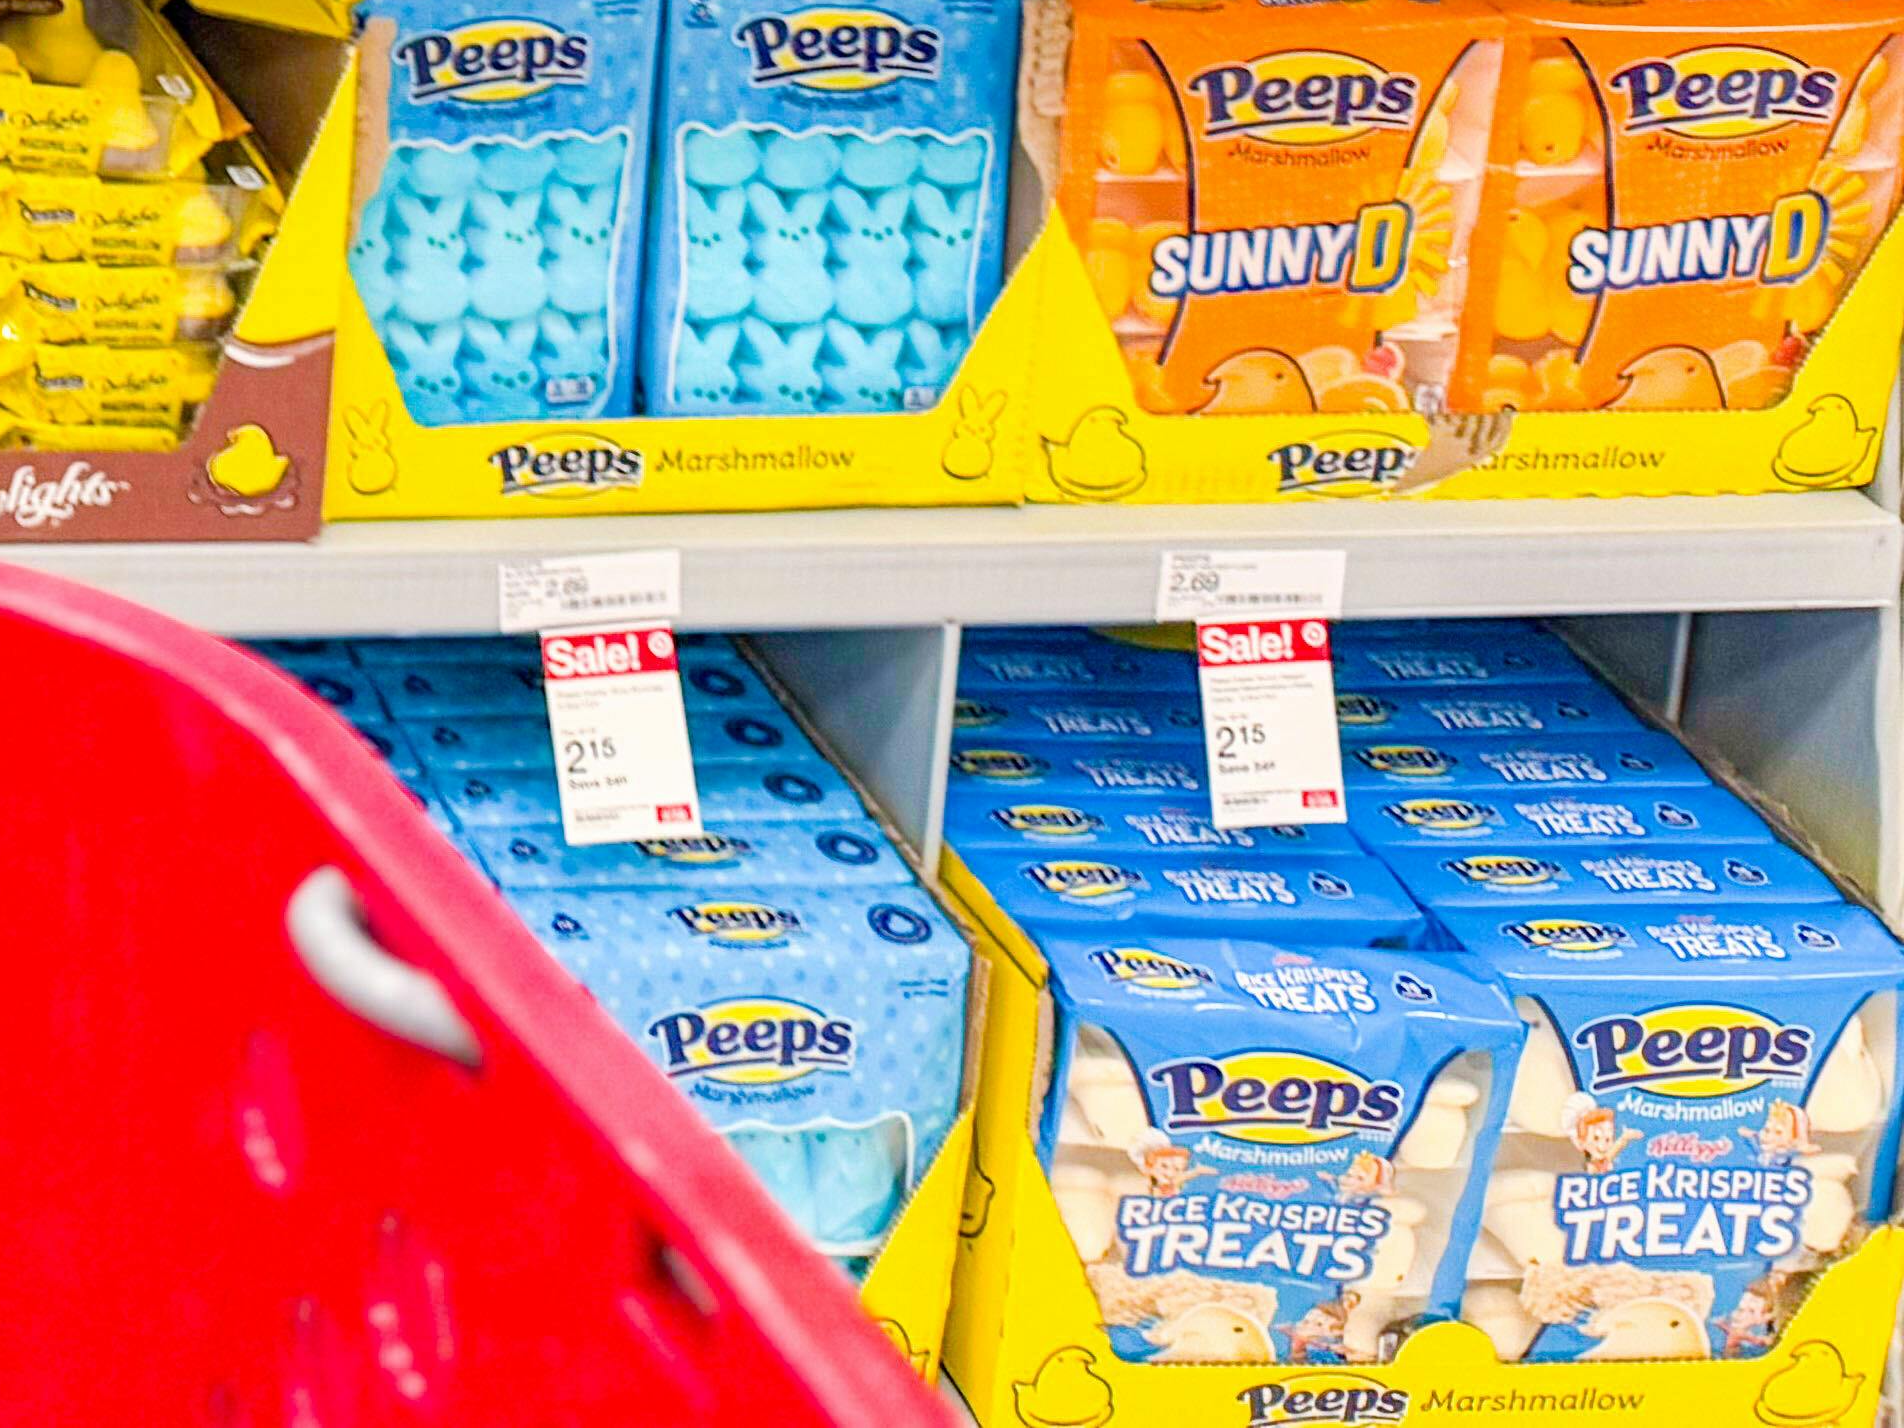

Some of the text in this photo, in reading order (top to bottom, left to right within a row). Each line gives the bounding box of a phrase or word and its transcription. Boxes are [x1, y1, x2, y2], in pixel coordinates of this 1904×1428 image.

[394, 29, 589, 91] Peeps
[736, 18, 940, 82] Peeps
[1190, 63, 1416, 130] Peeps
[1609, 58, 1838, 128] Peeps
[1226, 139, 1372, 169] Marshmallow
[1647, 134, 1790, 165] Marshmallow
[489, 439, 856, 492] Peeps Marshmallow
[1269, 440, 1666, 490] Peep arshmallow
[545, 633, 642, 677] Sale!
[1201, 623, 1296, 664] Sale!
[1492, 761, 1608, 784] TREATS
[1529, 813, 1647, 837] TREATS
[1021, 862, 1144, 889] Peeps
[1180, 881, 1296, 904] TREATS
[1592, 866, 1718, 893] TREATS
[669, 904, 800, 940] Peeps
[1502, 919, 1629, 948] Peeps
[1088, 946, 1214, 987] Peeps
[1661, 937, 1787, 961] TREATS
[1276, 967, 1369, 988] KRISPIES
[1252, 985, 1377, 1013] TREATS
[649, 1014, 853, 1070] Peeps
[1576, 1018, 1809, 1086] Peeps
[1151, 1064, 1401, 1134] Peeps
[1616, 1096, 1765, 1123] Marshmallow
[1195, 1137, 1350, 1166] Marshmallow
[1557, 1164, 1810, 1208] RICE KRISPIES
[1121, 1195, 1390, 1235] RICE KRISPIES
[1564, 1204, 1796, 1258] TREATS
[1125, 1225, 1376, 1276] TREATS
[1238, 1382, 1645, 1421] Peeps Marshmallow
